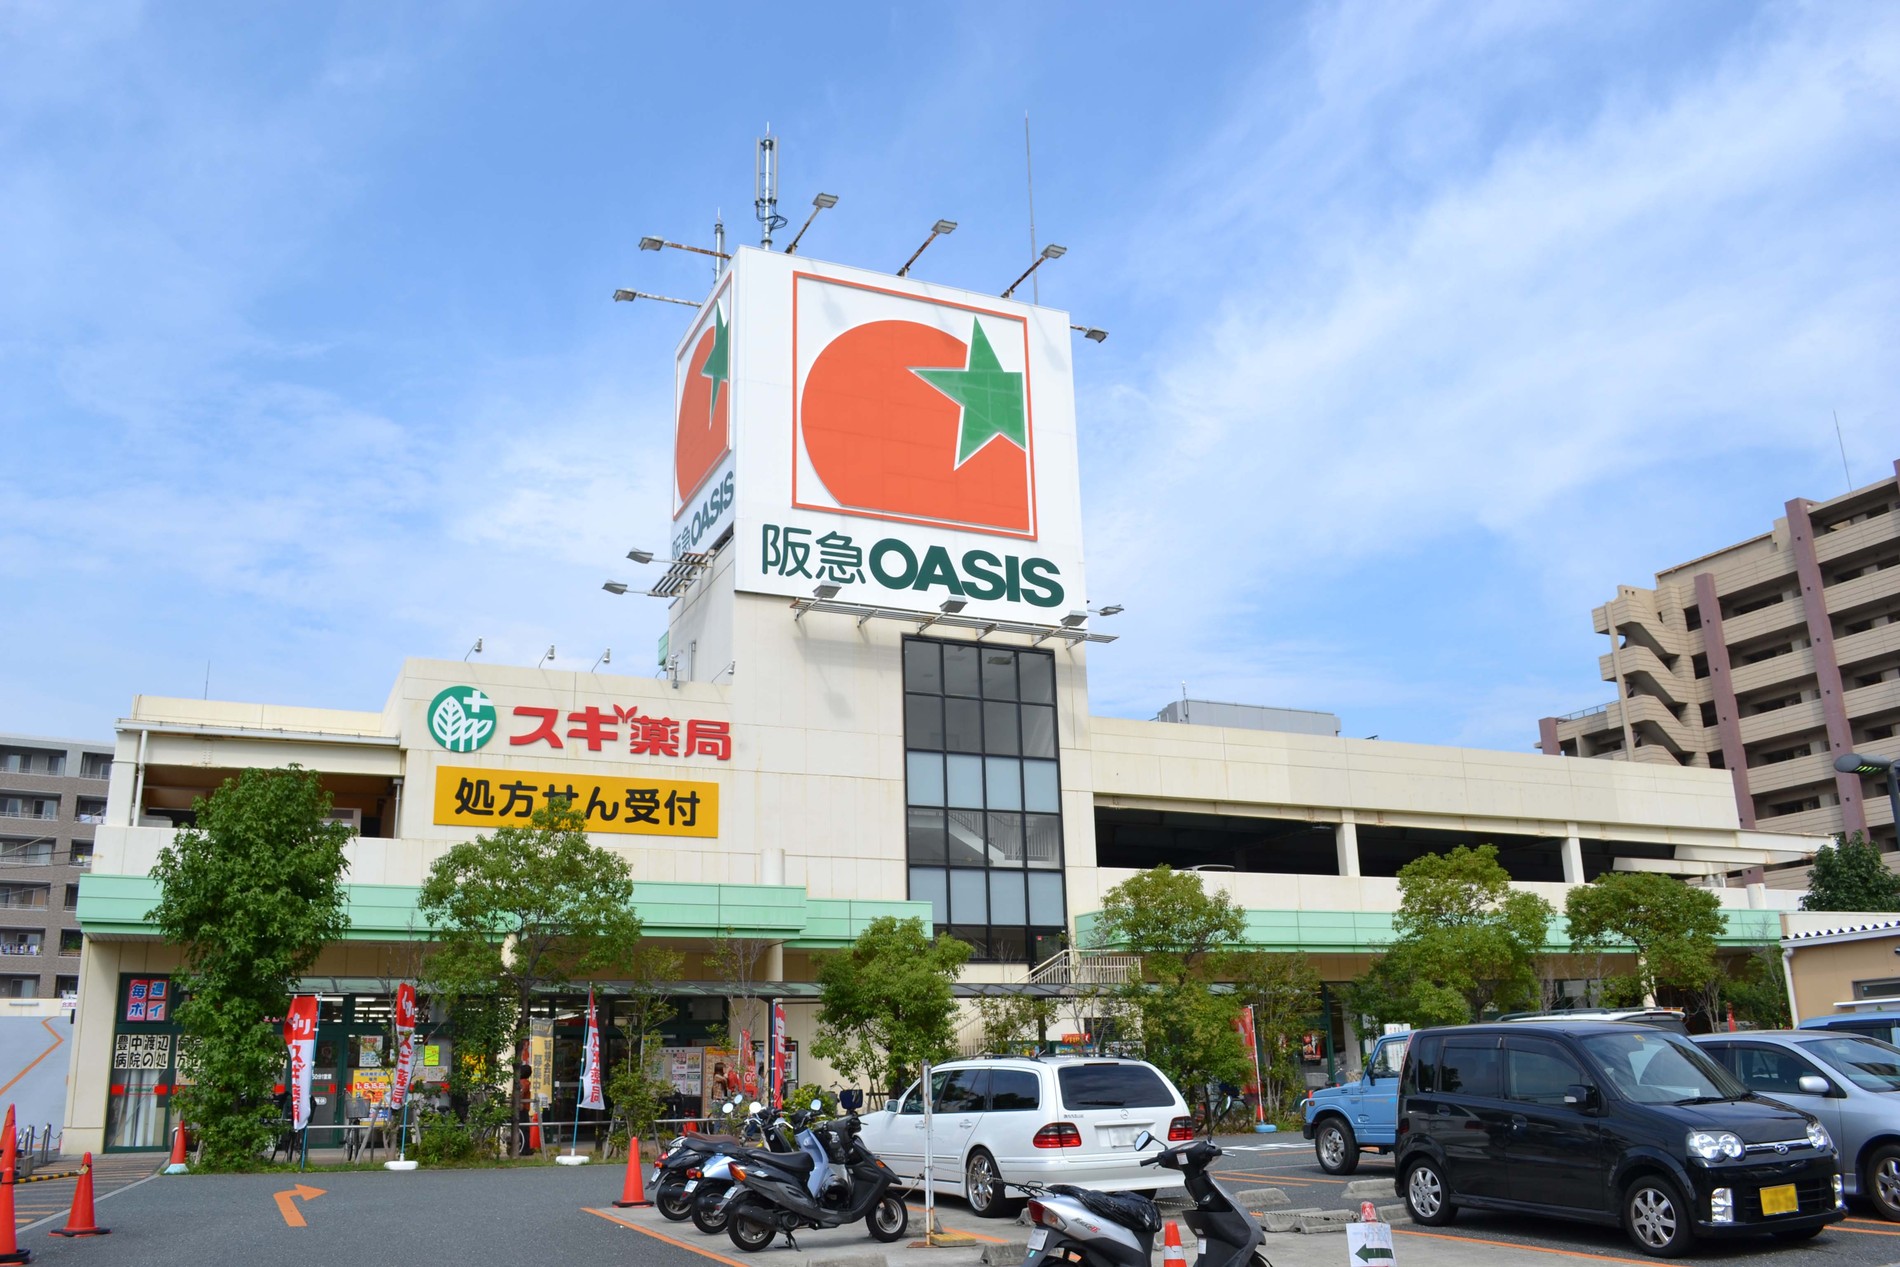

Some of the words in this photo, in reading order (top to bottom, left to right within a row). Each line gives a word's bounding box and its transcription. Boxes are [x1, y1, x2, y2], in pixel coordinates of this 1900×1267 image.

[509, 703, 732, 761] スギ薬局
[392, 1031, 412, 1104] スギ薬局
